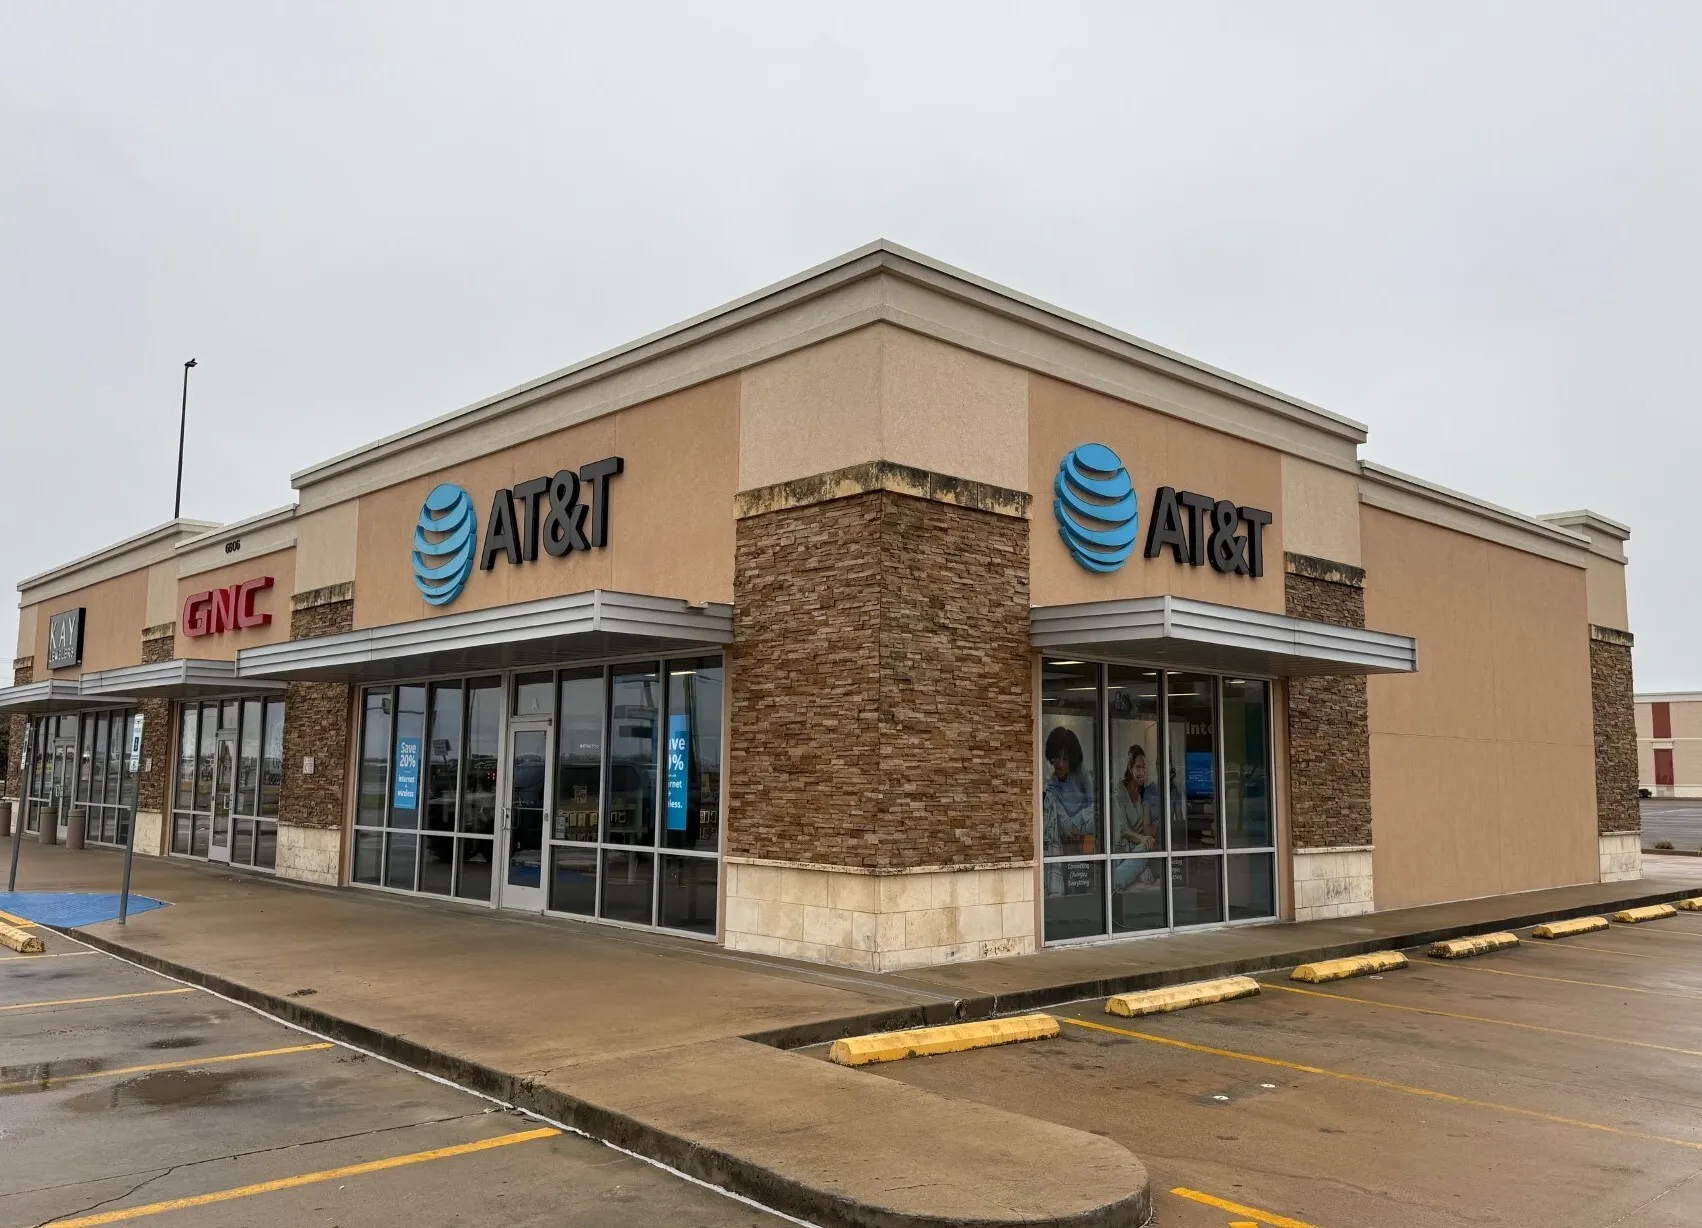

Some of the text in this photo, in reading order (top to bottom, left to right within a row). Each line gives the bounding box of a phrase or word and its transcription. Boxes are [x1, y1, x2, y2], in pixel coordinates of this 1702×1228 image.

[480, 456, 624, 570] AT&T
[1144, 486, 1272, 577] AT&T
[183, 576, 275, 637] GNC
[50, 616, 76, 650] KAY
[401, 743, 416, 753] Save
[669, 738, 685, 750] ve
[400, 755, 416, 768] 20%
